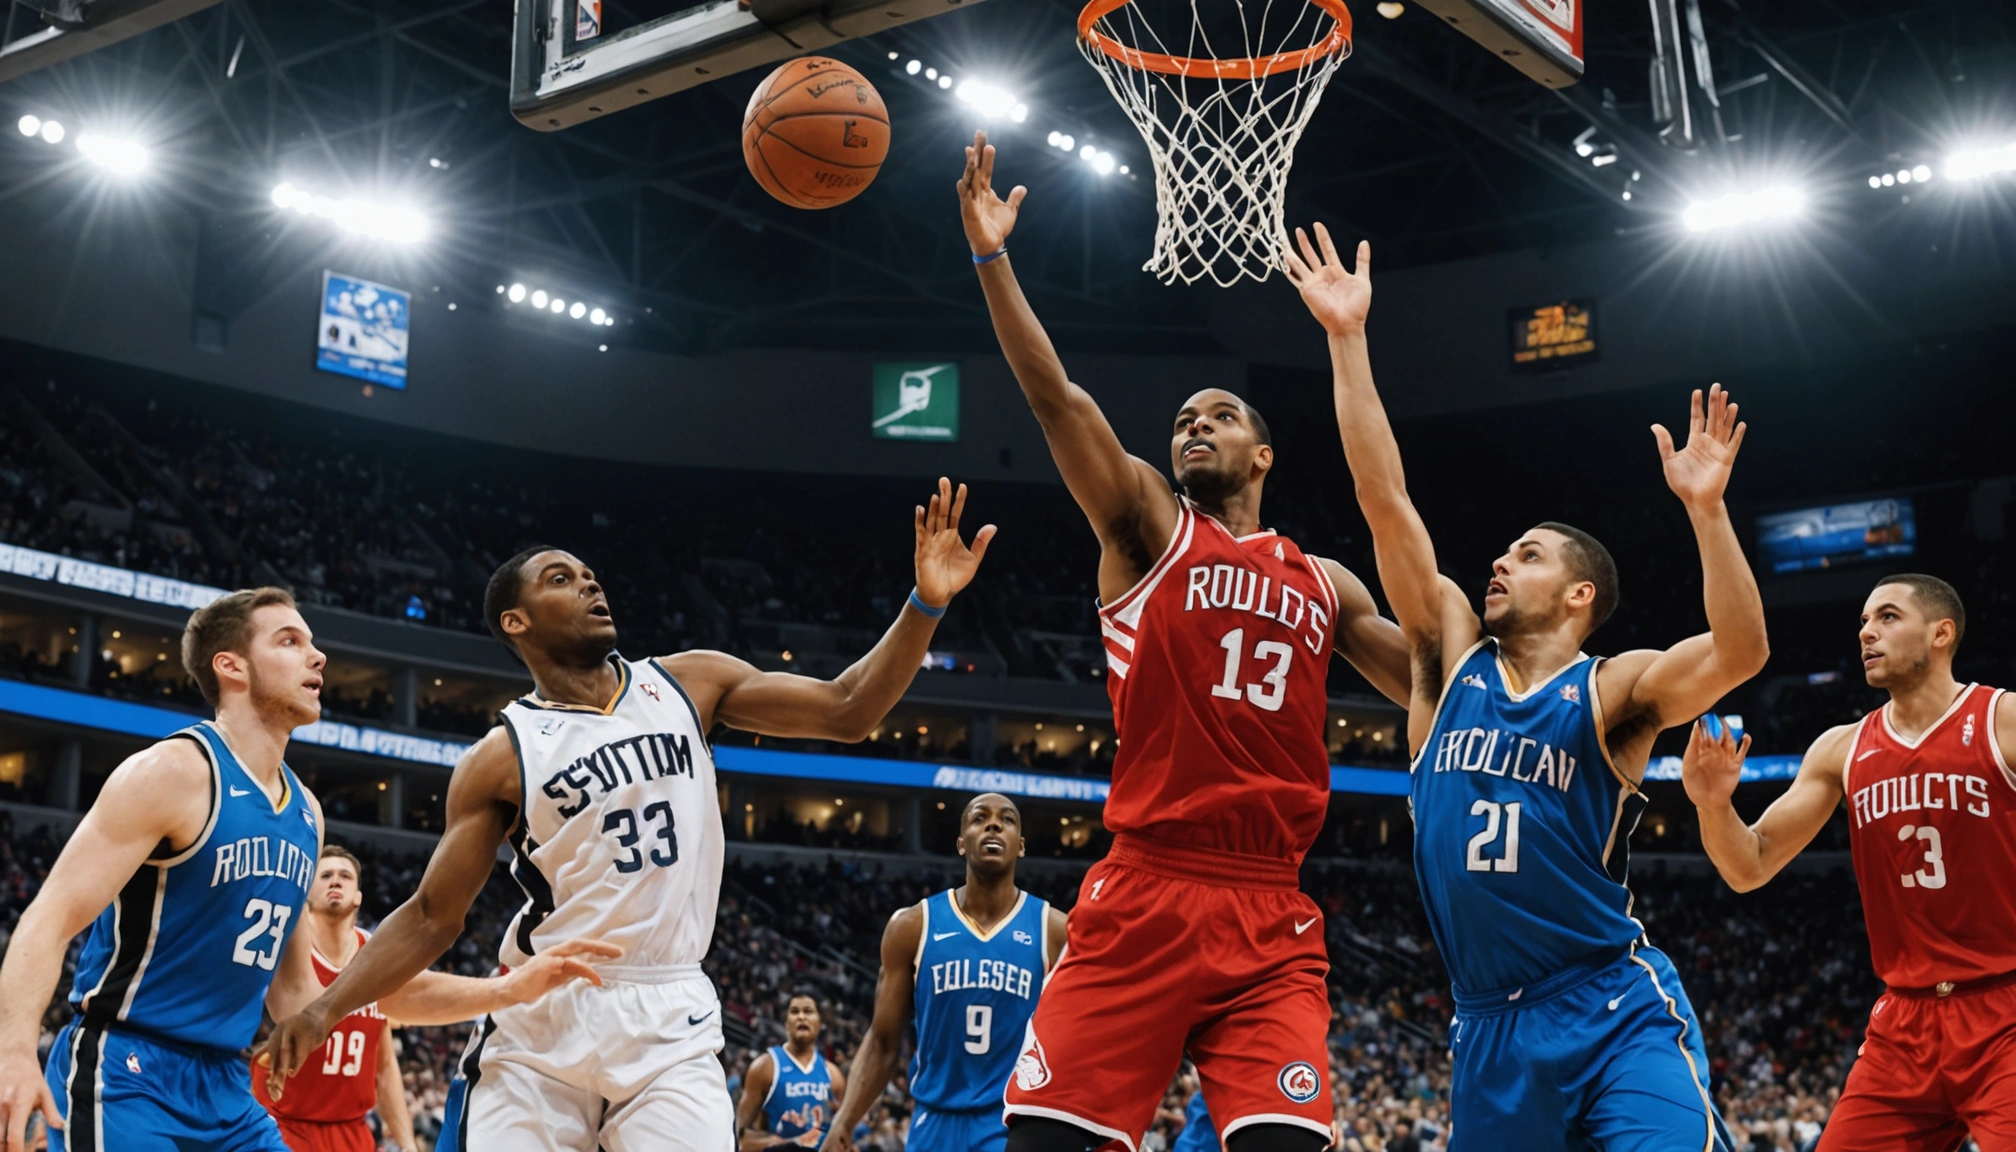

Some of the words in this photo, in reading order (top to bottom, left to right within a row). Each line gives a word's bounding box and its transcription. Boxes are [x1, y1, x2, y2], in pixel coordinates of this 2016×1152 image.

[1211, 628, 1293, 711] 13
[601, 800, 679, 873] 33
[1466, 799, 1521, 873] 21
[232, 898, 292, 971] 23
[964, 1004, 993, 1055] 9
